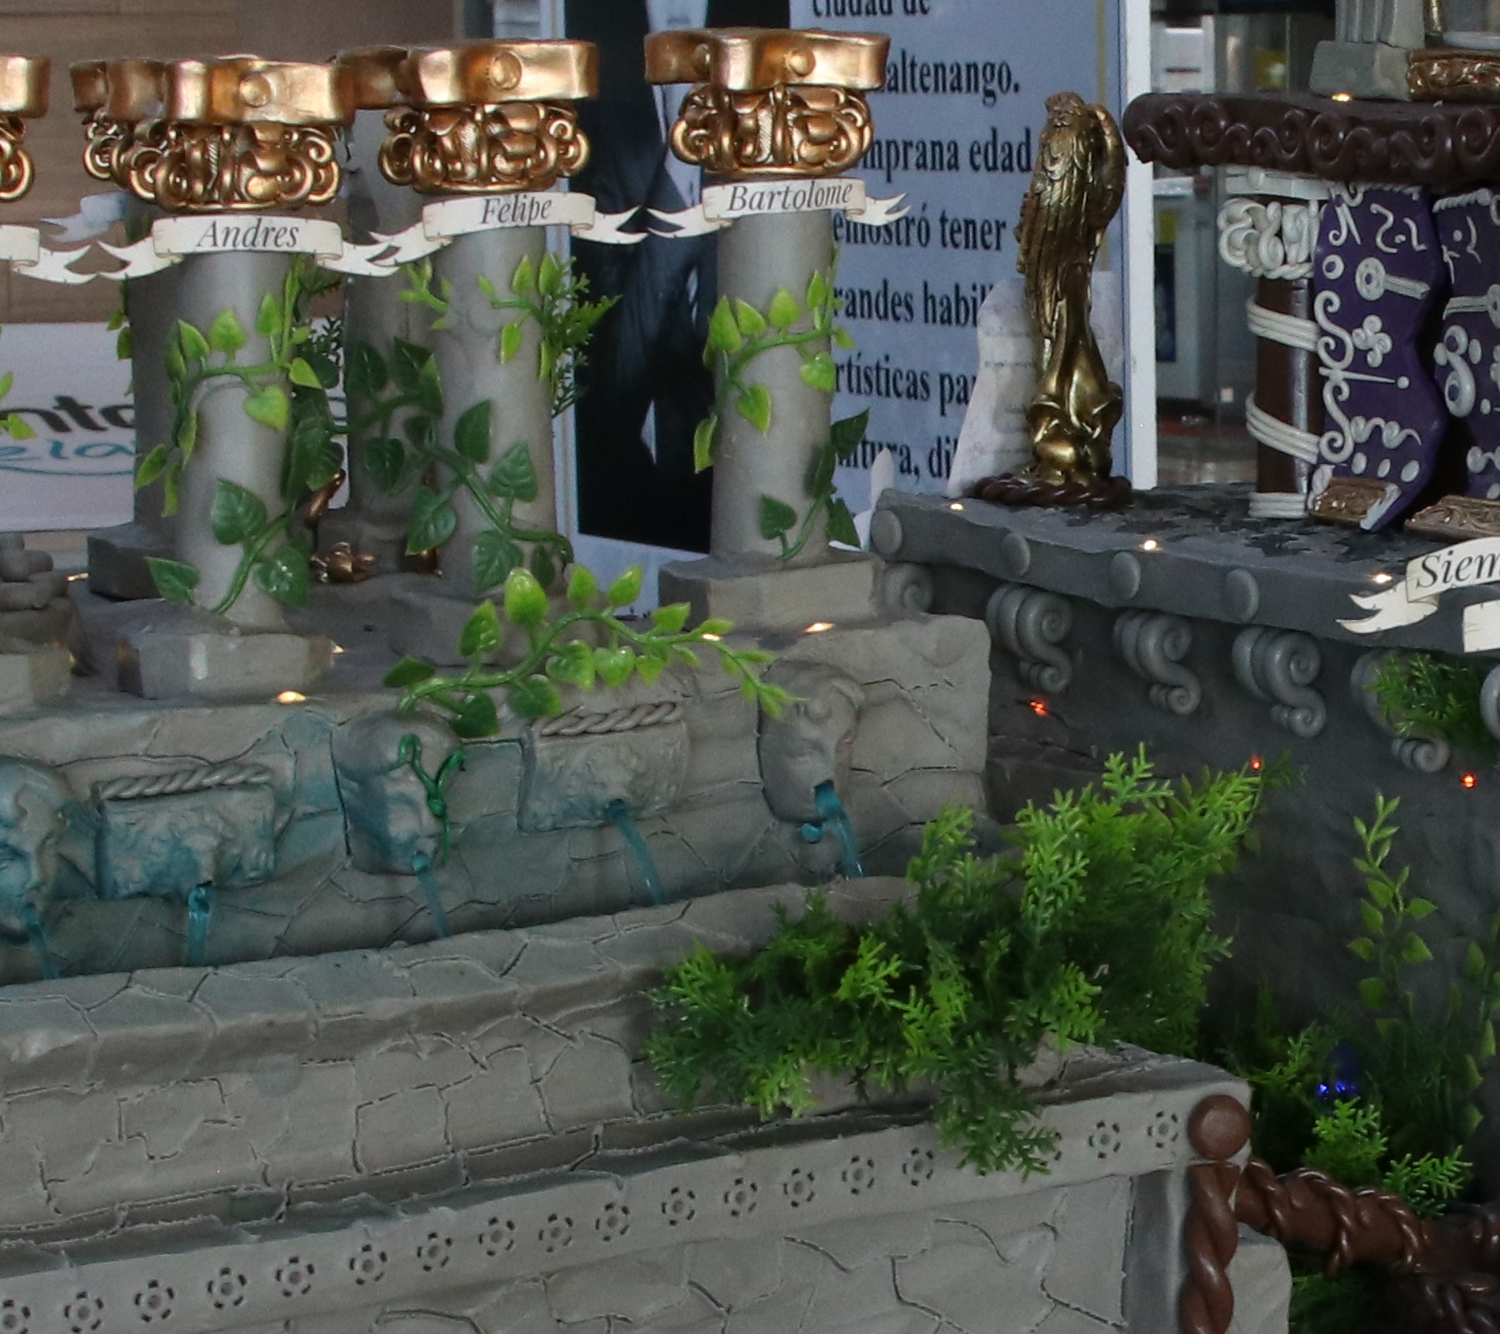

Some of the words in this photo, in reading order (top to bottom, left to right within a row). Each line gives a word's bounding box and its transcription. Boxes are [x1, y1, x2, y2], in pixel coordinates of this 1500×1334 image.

[884, 48, 1020, 107] altenango.
[862, 137, 960, 183] mprana
[969, 127, 1032, 172] edad
[481, 196, 552, 226] Felipe
[726, 180, 854, 214] Bartolome
[199, 218, 300, 249] Andres
[833, 202, 931, 248] emostró
[940, 210, 1007, 251] tener
[834, 278, 914, 323] randes
[835, 351, 930, 401] rtísticas
